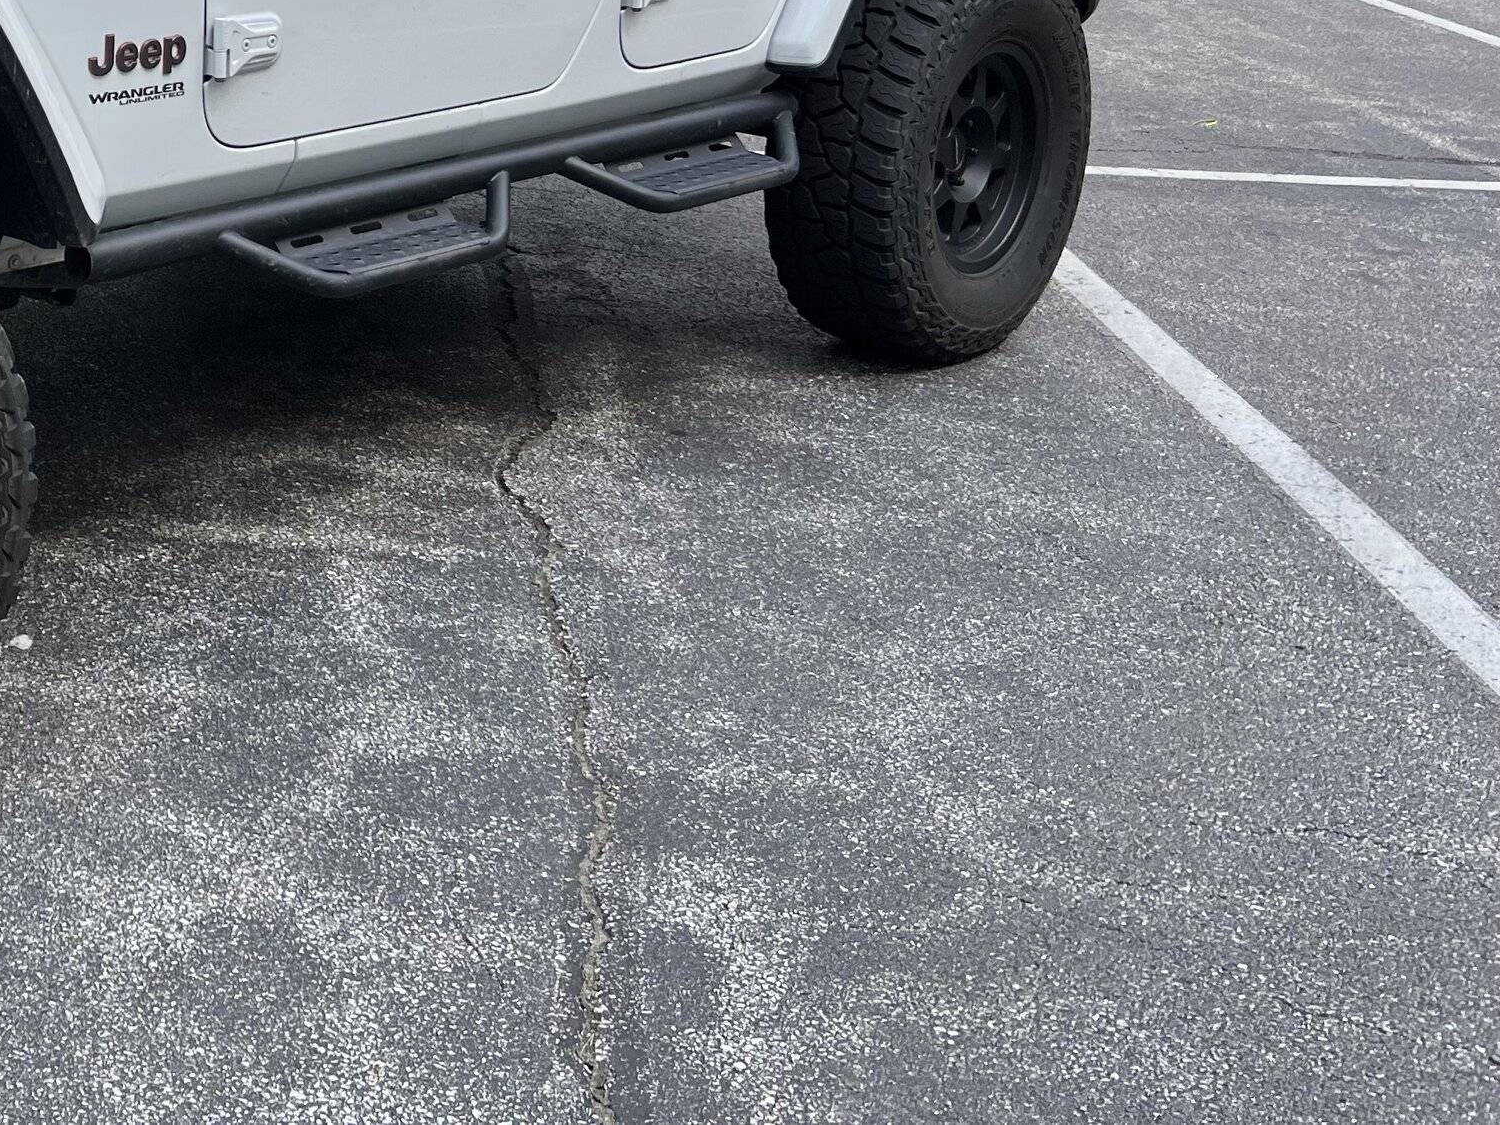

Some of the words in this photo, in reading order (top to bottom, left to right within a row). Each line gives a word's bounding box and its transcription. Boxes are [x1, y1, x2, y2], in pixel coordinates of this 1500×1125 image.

[88, 33, 187, 77] Jeep
[88, 81, 185, 105] WRANGLER
[118, 90, 185, 106] UNLIMITED
